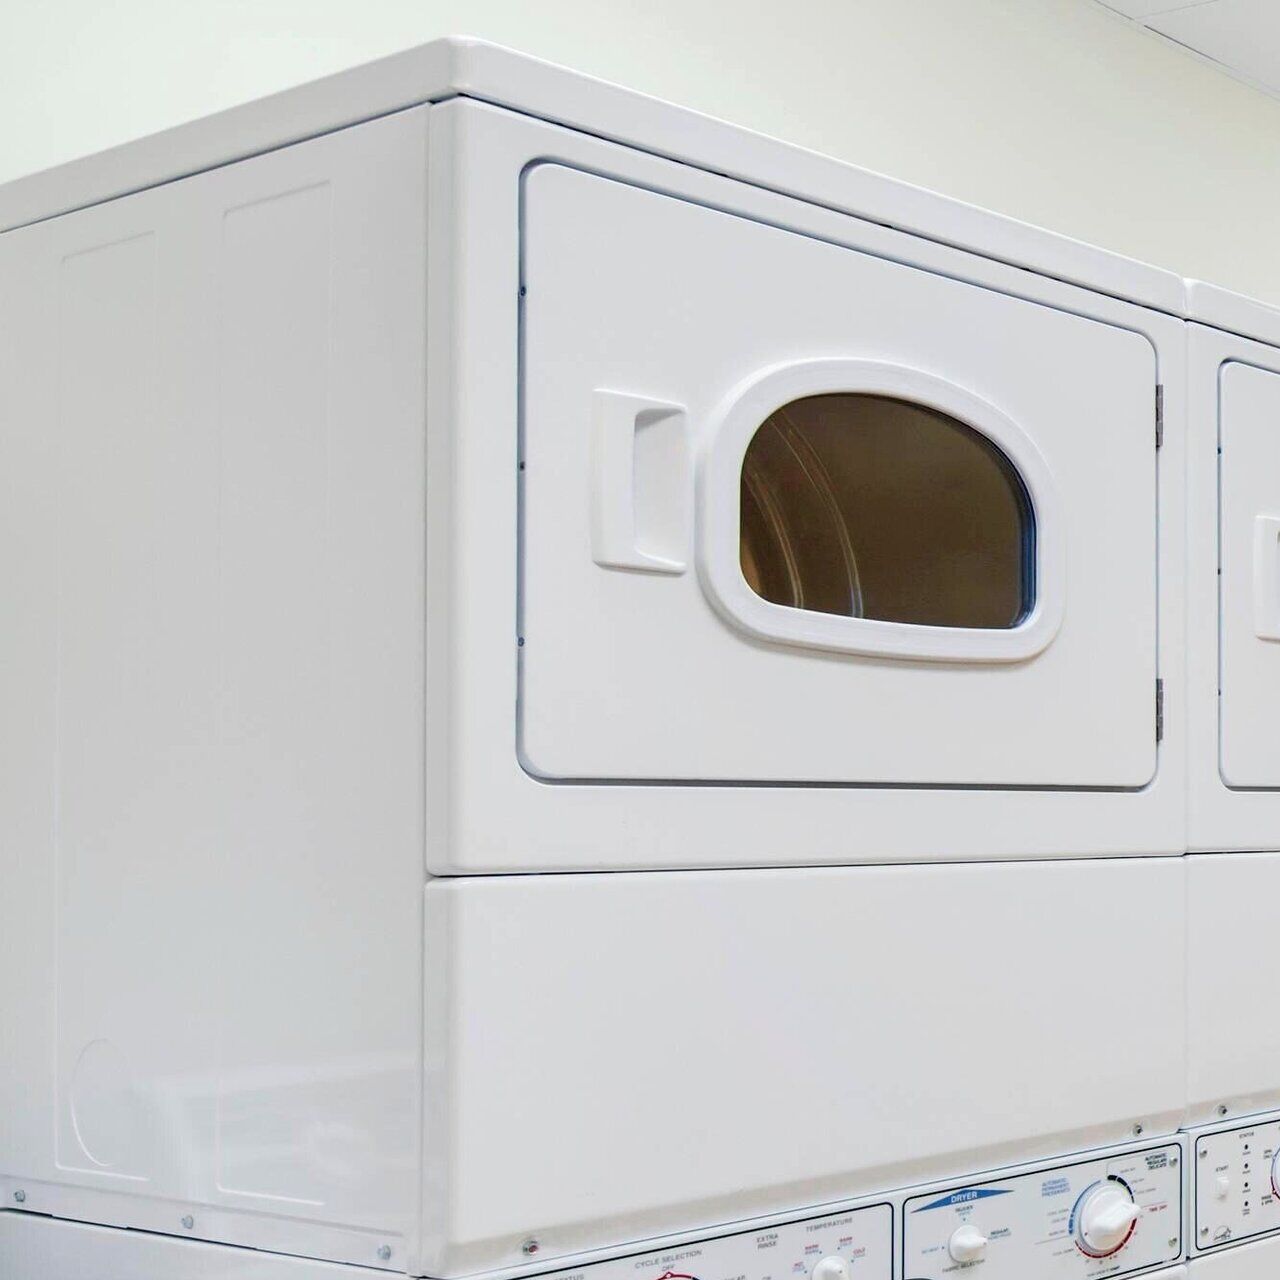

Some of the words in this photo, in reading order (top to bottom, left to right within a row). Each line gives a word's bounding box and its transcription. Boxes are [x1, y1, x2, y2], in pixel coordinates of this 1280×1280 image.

[950, 1191, 977, 1203] DRYER
[806, 1218, 853, 1232] TEMPERATURE
[634, 1257, 660, 1269] CYCLE
[661, 1250, 703, 1263] SELECTION
